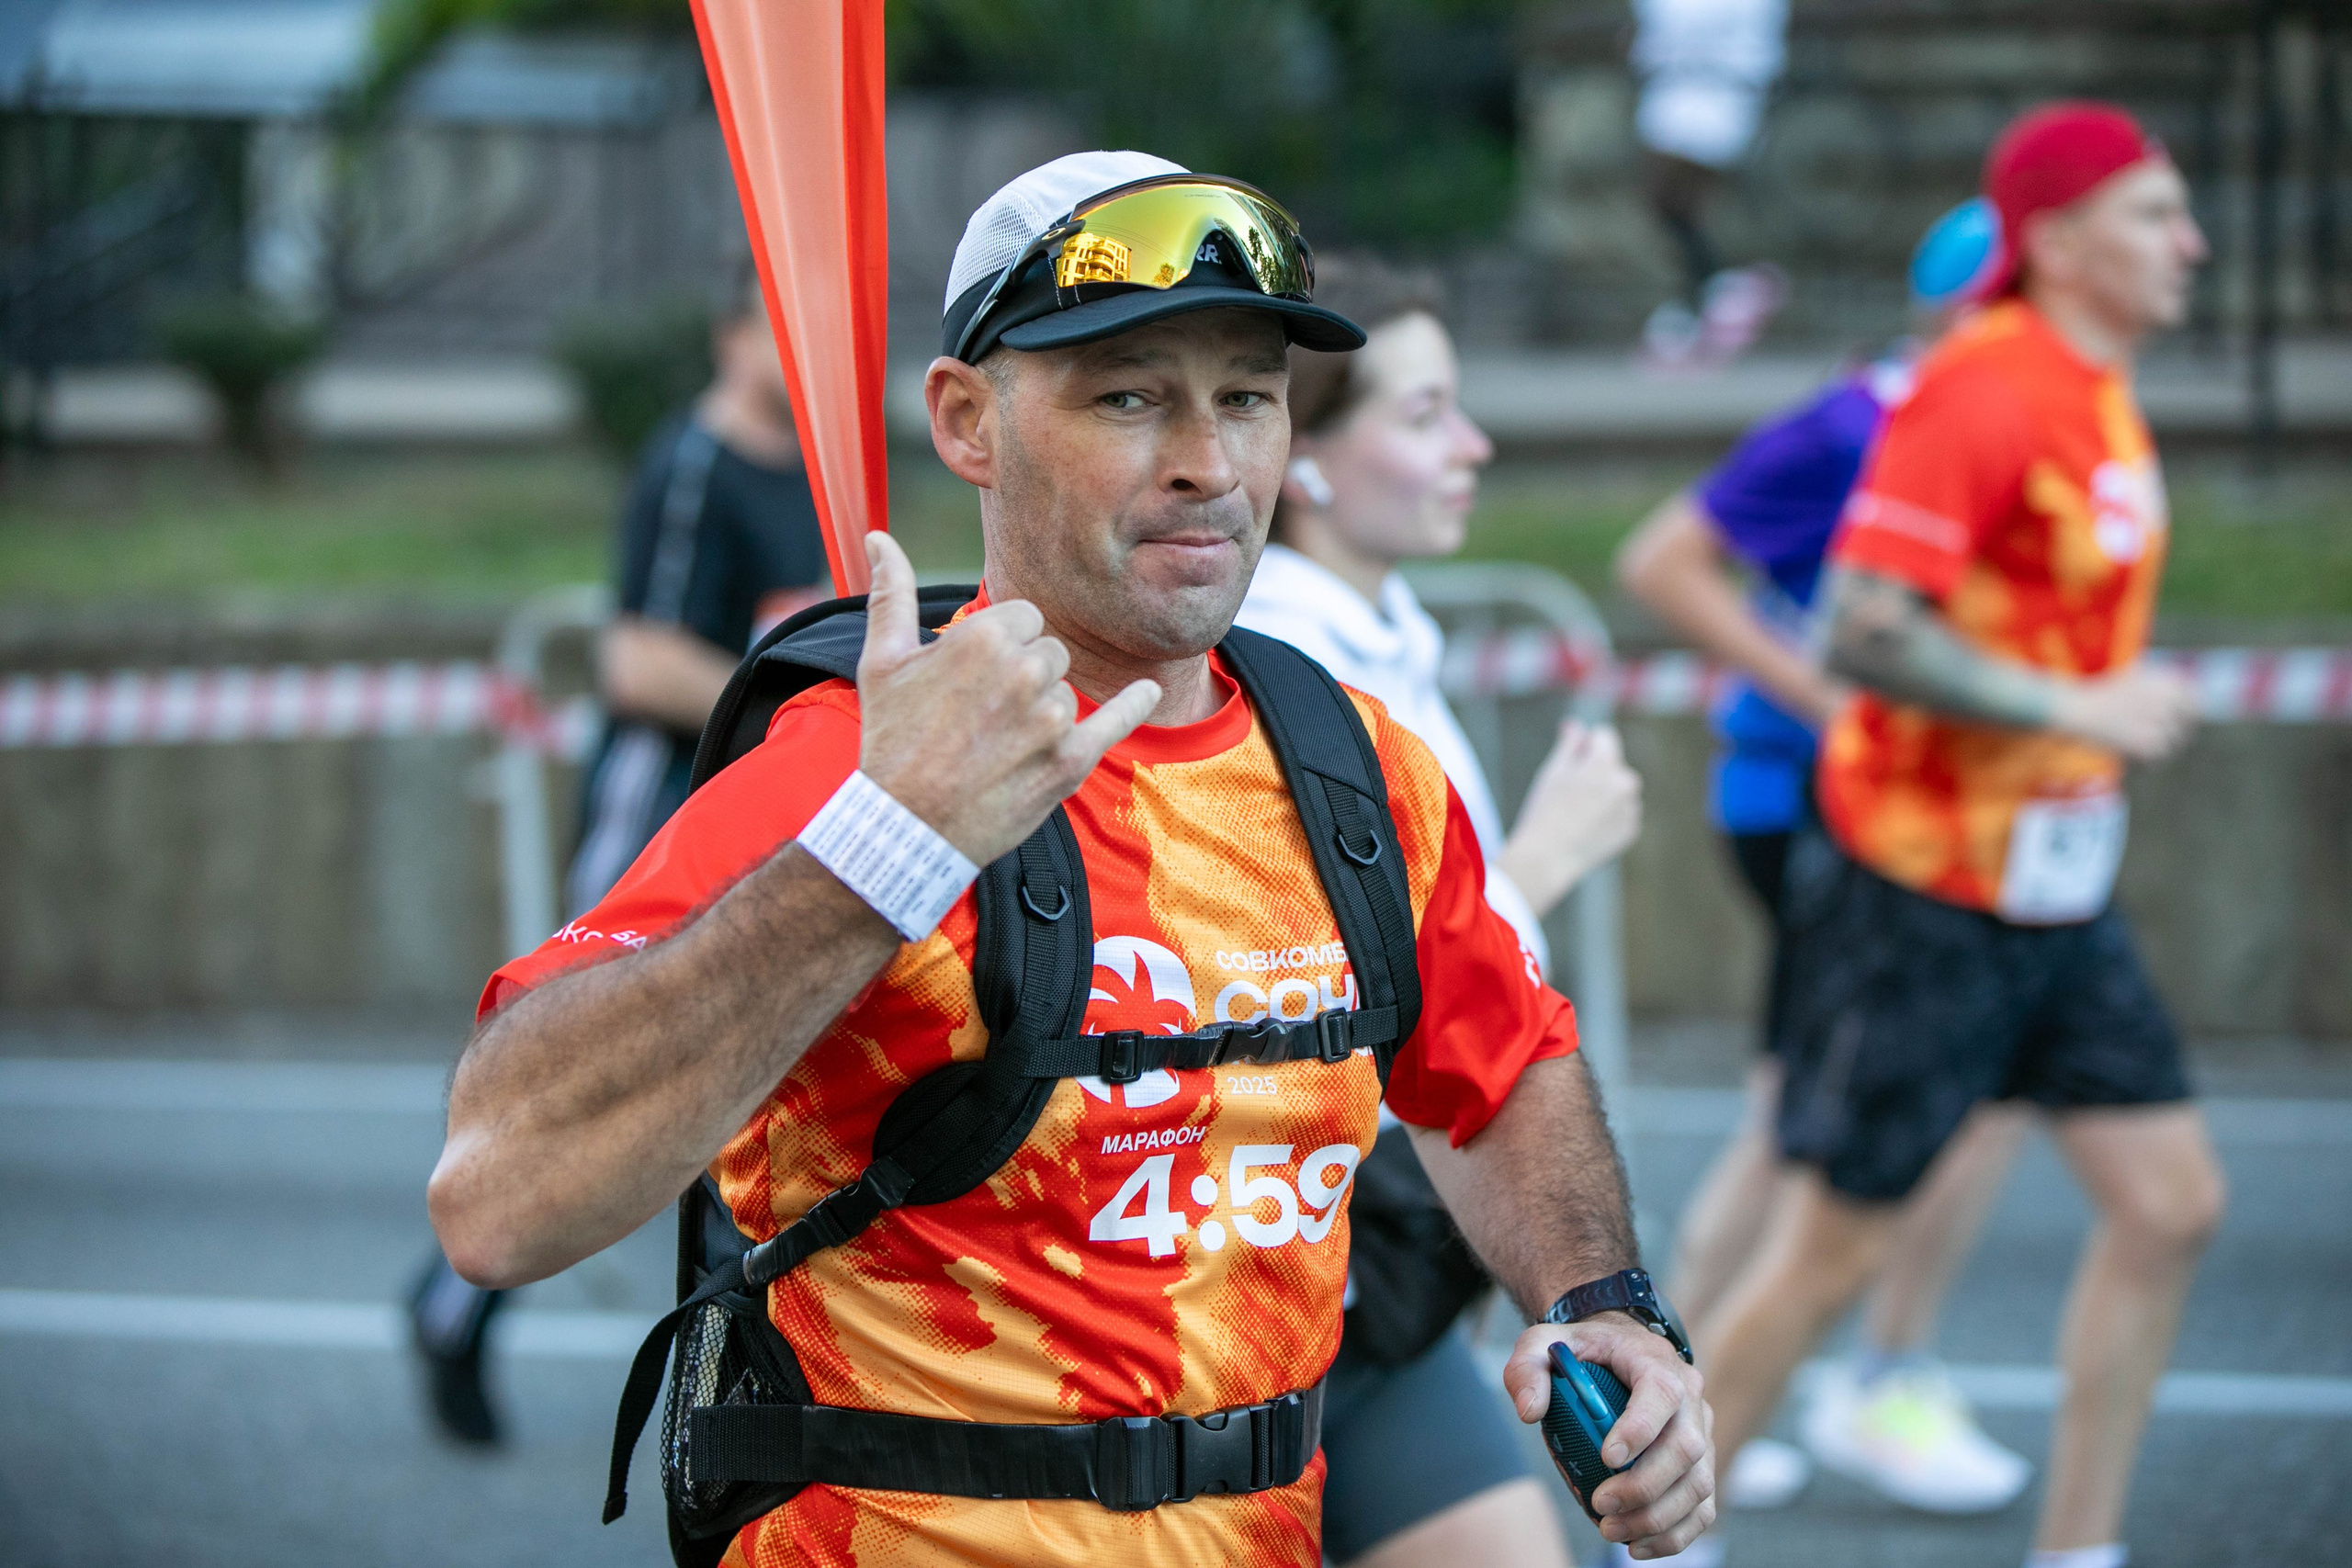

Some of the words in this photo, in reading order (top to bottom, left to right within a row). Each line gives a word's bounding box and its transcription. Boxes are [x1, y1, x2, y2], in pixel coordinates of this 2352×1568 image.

[1216, 942, 1350, 972] СОВКОМБ
[1214, 973, 1361, 1026] СОЧ
[1227, 1076, 1277, 1095] 2025
[1101, 1125, 1206, 1155] МАРАФОН
[1089, 1144, 1362, 1258] 4:59
